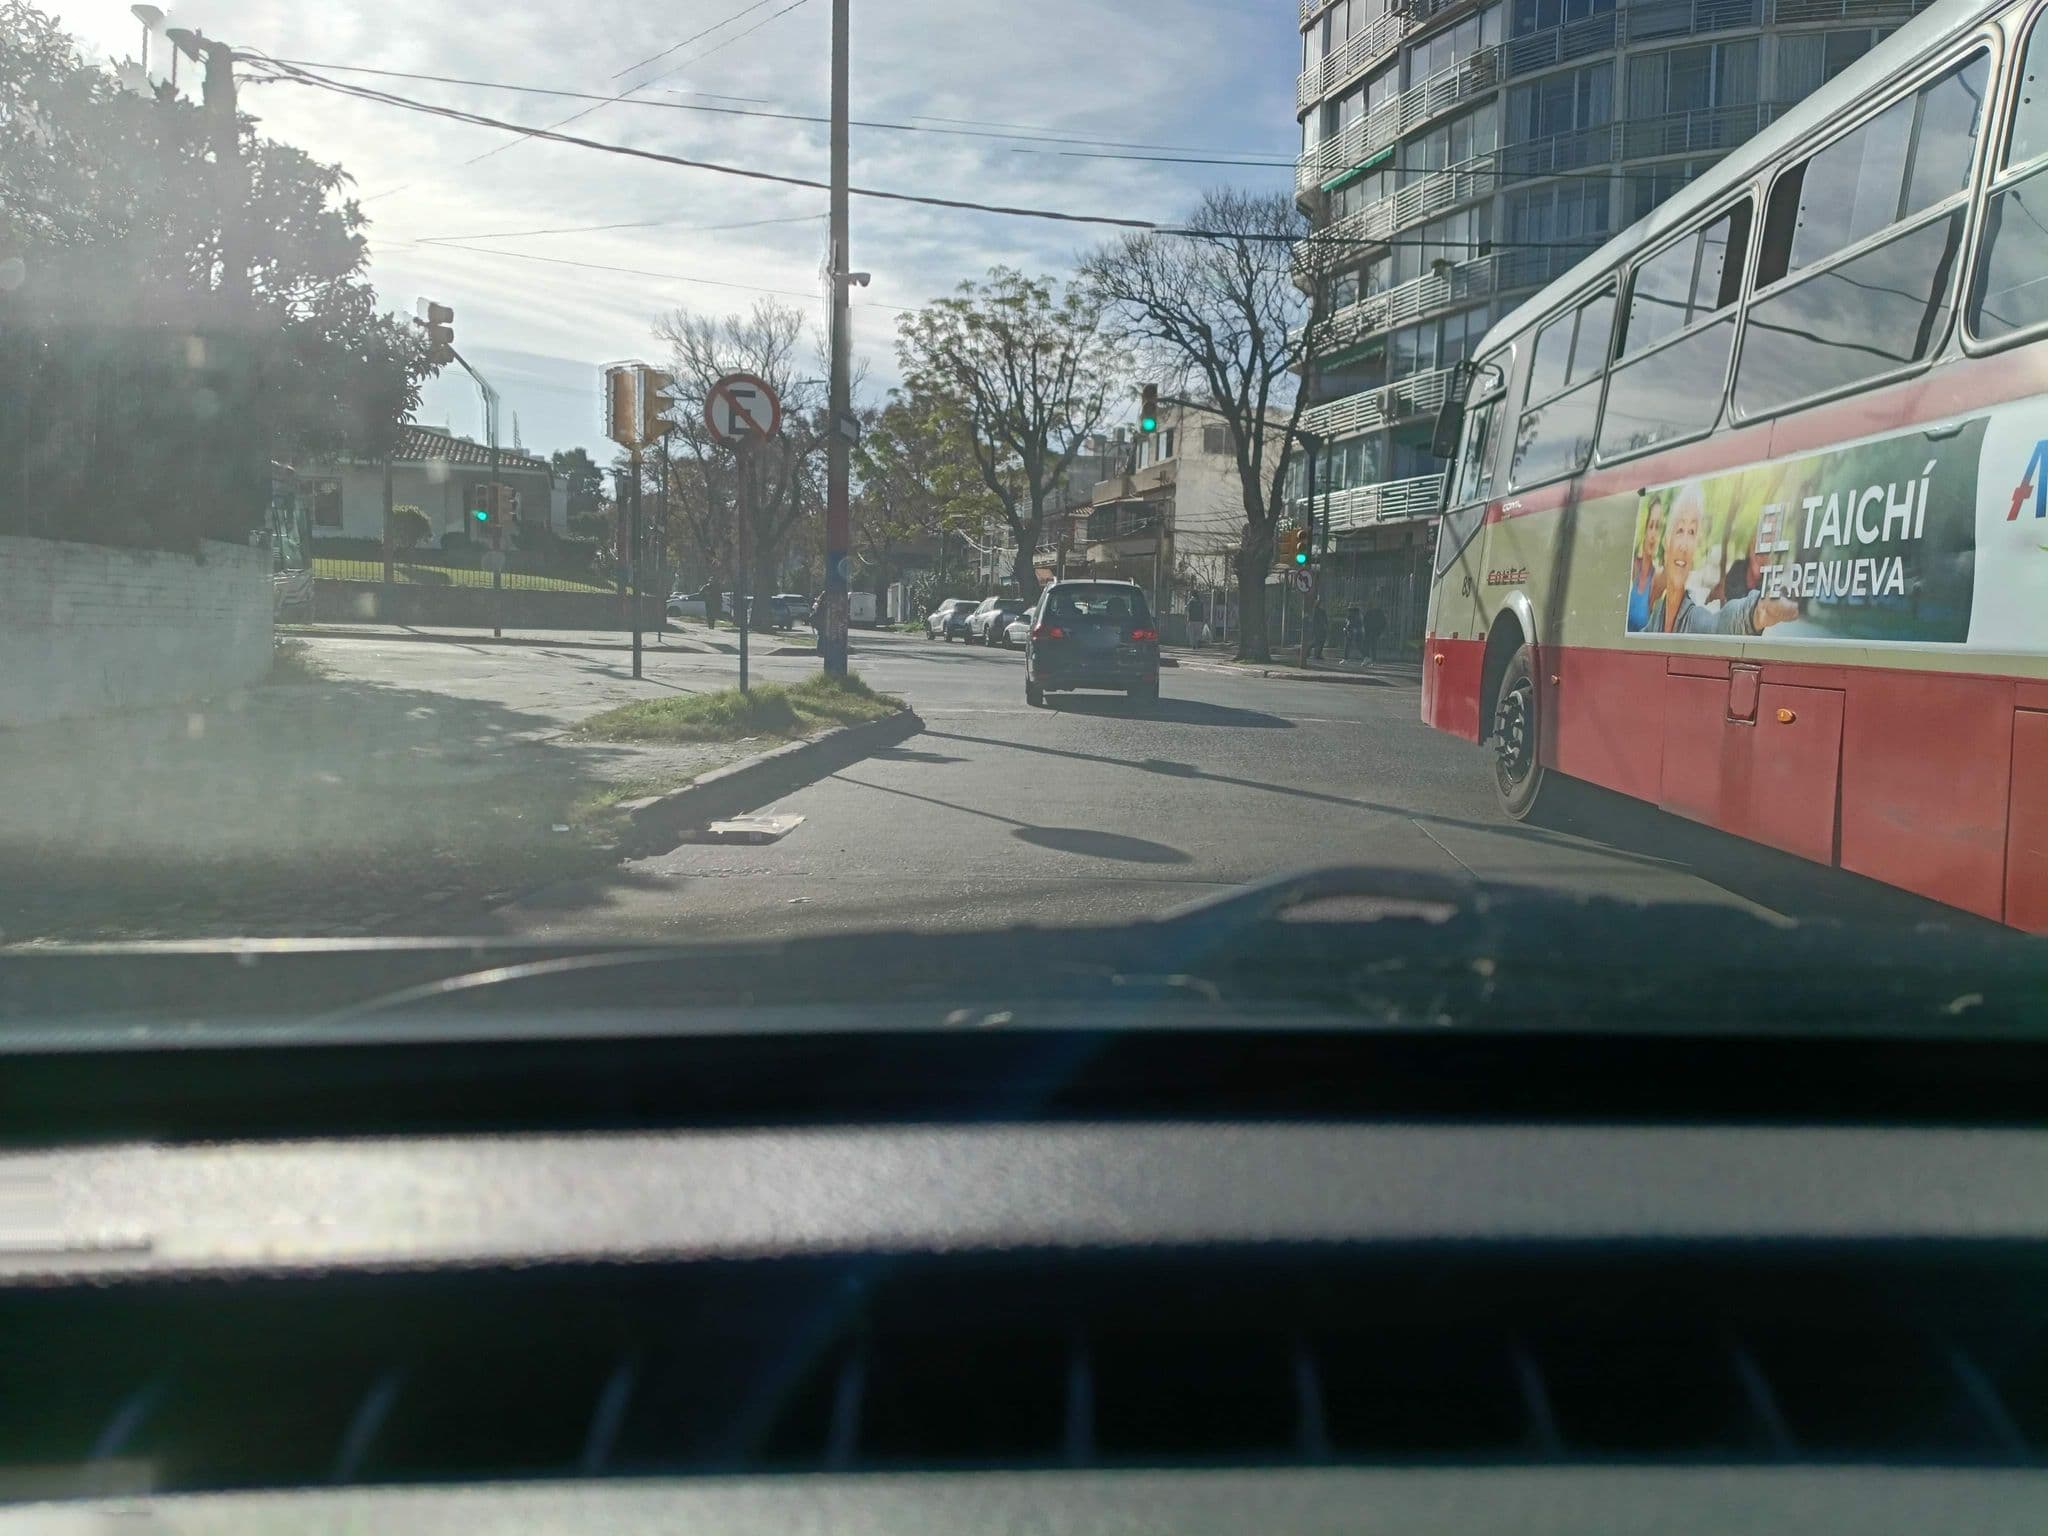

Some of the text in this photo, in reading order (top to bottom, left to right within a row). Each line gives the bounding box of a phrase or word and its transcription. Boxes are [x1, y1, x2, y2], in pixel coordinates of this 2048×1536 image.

[1755, 459, 1937, 554] EL TAICHÍ
[1760, 556, 1905, 599] TE RENUEVA
